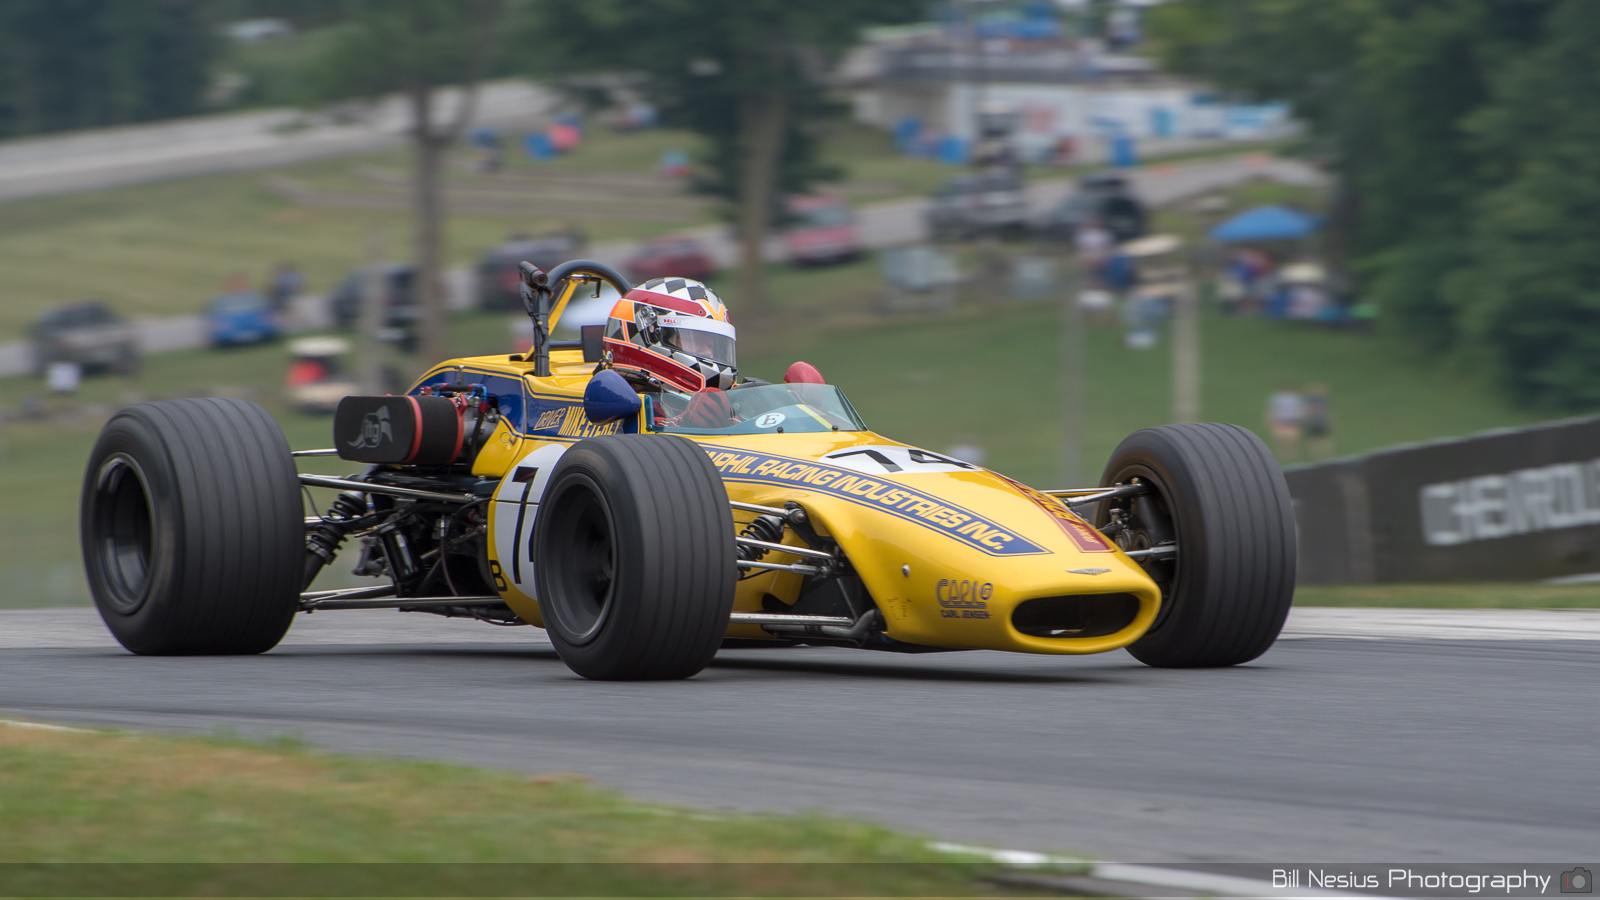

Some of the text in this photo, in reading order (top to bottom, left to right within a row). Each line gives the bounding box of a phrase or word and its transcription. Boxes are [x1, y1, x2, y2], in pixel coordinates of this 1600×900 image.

[533, 407, 566, 430] DRIVER
[558, 406, 587, 437] MIKE
[761, 414, 780, 426] E
[826, 449, 978, 473] 74
[750, 459, 842, 486] RACING
[832, 476, 966, 527] INDUSTRIES
[953, 517, 1014, 550] INC.
[512, 466, 539, 584] 7
[489, 560, 507, 592] B
[936, 578, 987, 609] CARL
[941, 610, 991, 619] CARL JENSEN
